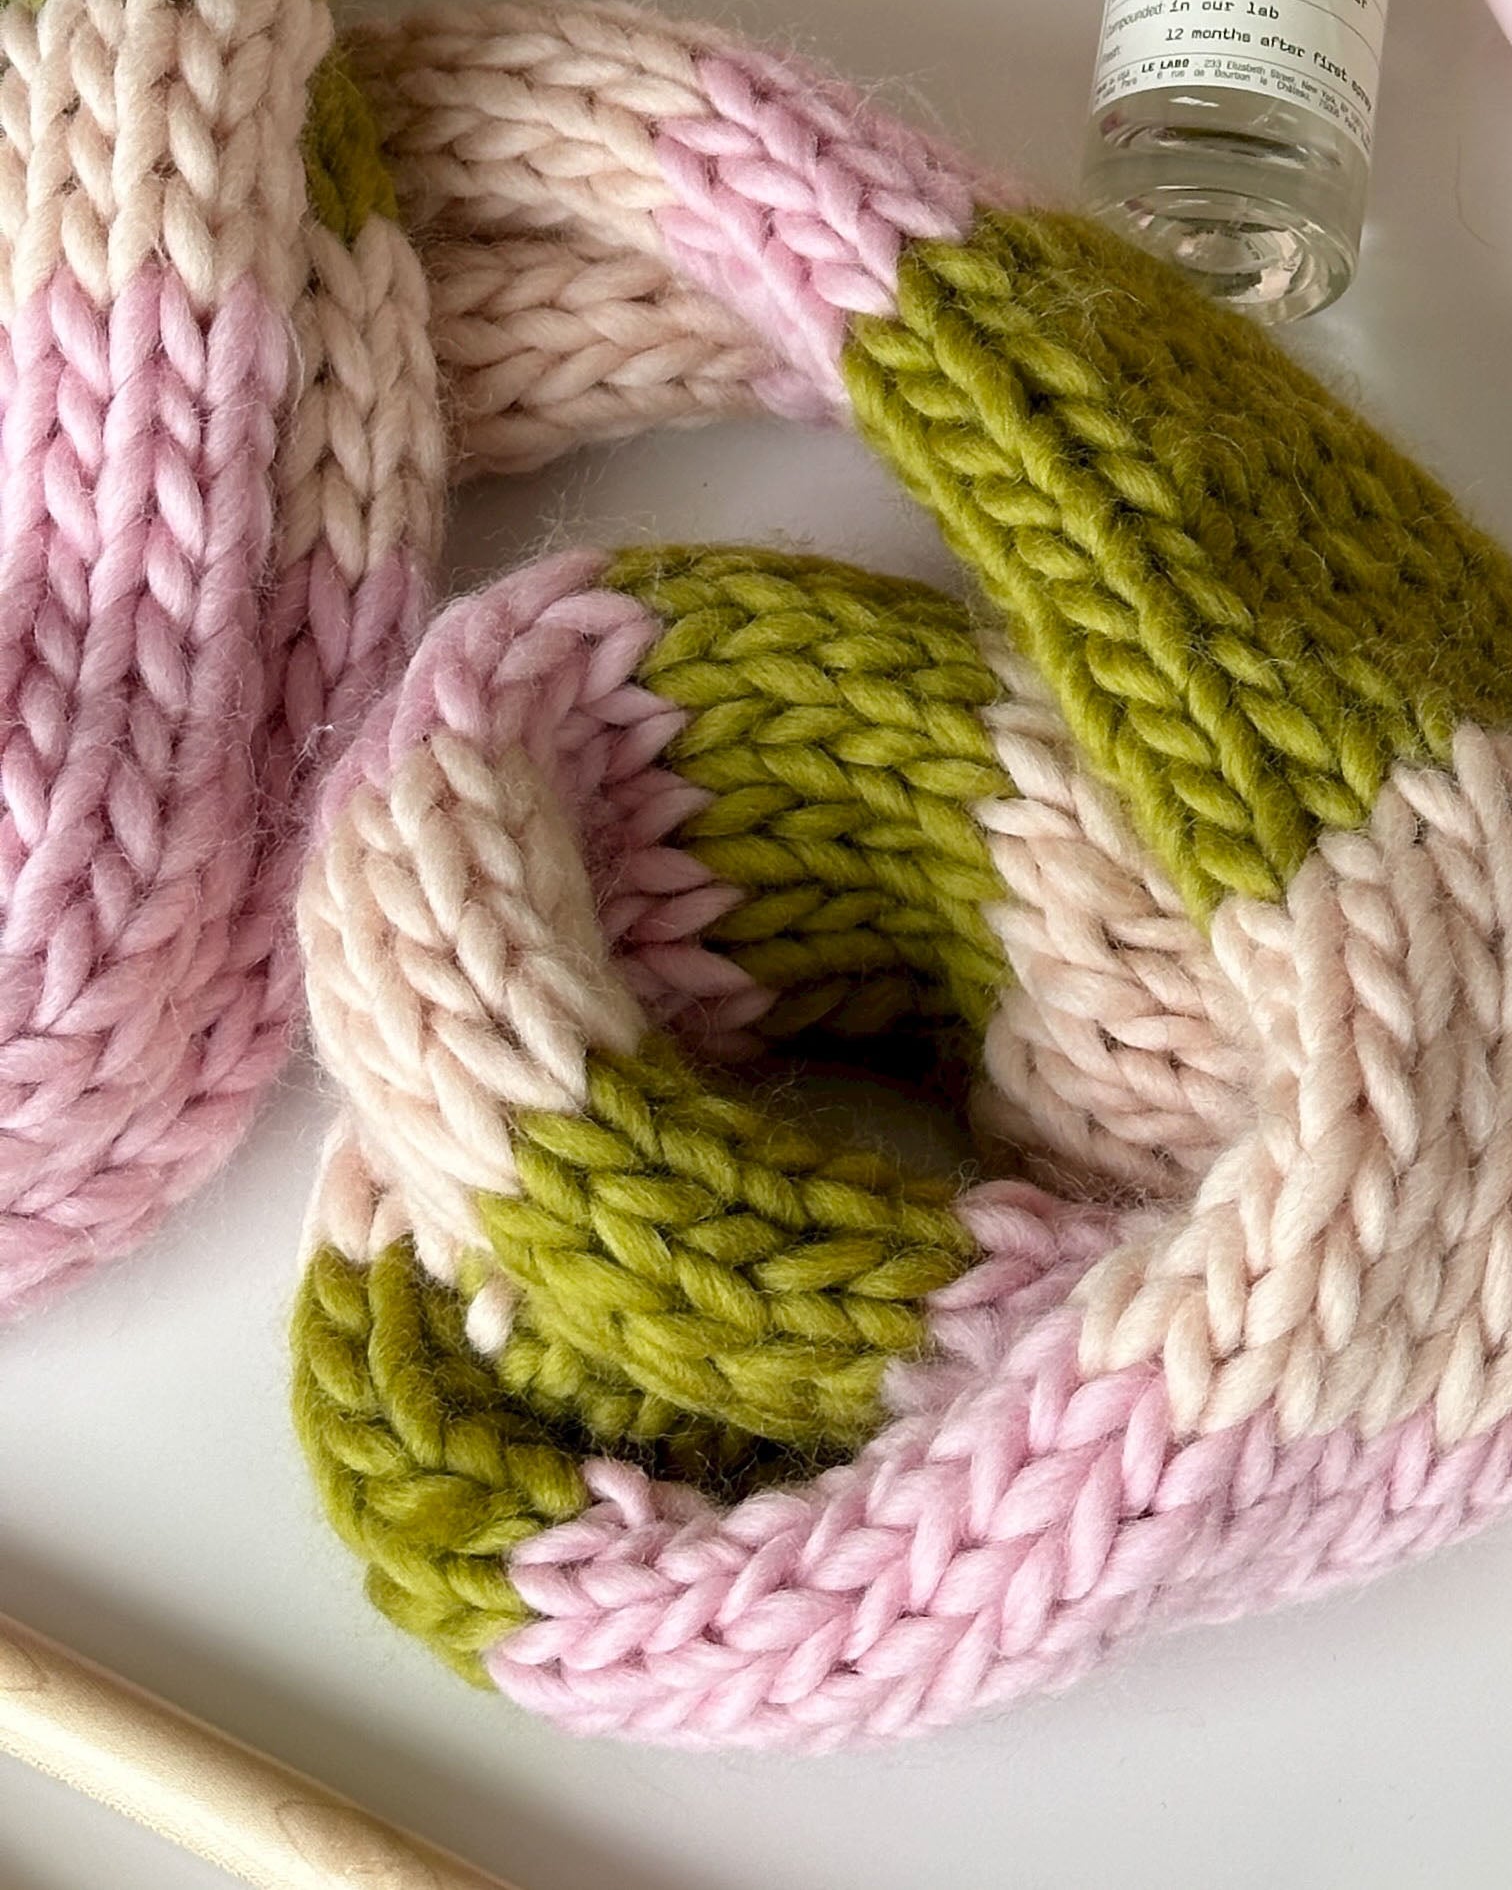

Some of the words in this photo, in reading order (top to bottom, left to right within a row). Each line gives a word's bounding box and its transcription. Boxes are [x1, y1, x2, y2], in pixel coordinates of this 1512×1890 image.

[1169, 0, 1190, 13] in
[1201, 0, 1235, 12] our
[1246, 1, 1280, 20] lab
[1165, 28, 1184, 42] 12
[1191, 27, 1250, 44] months
[1260, 36, 1306, 58] after
[1313, 51, 1348, 83] first
[1141, 61, 1155, 73] LE
[1160, 58, 1190, 70] LABO
